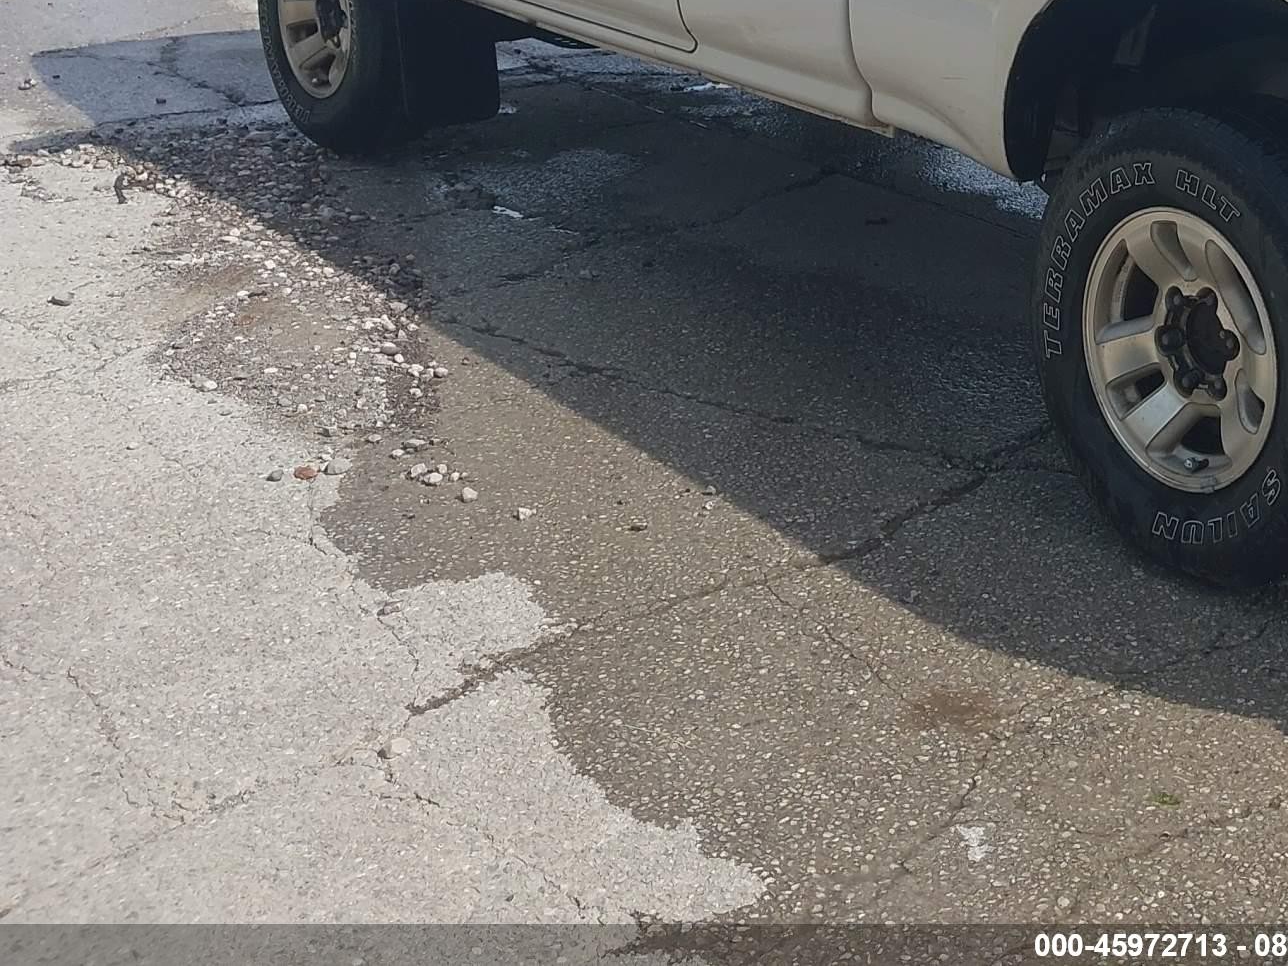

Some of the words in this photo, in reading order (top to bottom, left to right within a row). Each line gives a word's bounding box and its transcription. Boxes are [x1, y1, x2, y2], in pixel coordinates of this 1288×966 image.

[1043, 161, 1156, 360] TERRAMAX
[1175, 168, 1240, 223] HLT
[1151, 469, 1281, 545] SAILUN
